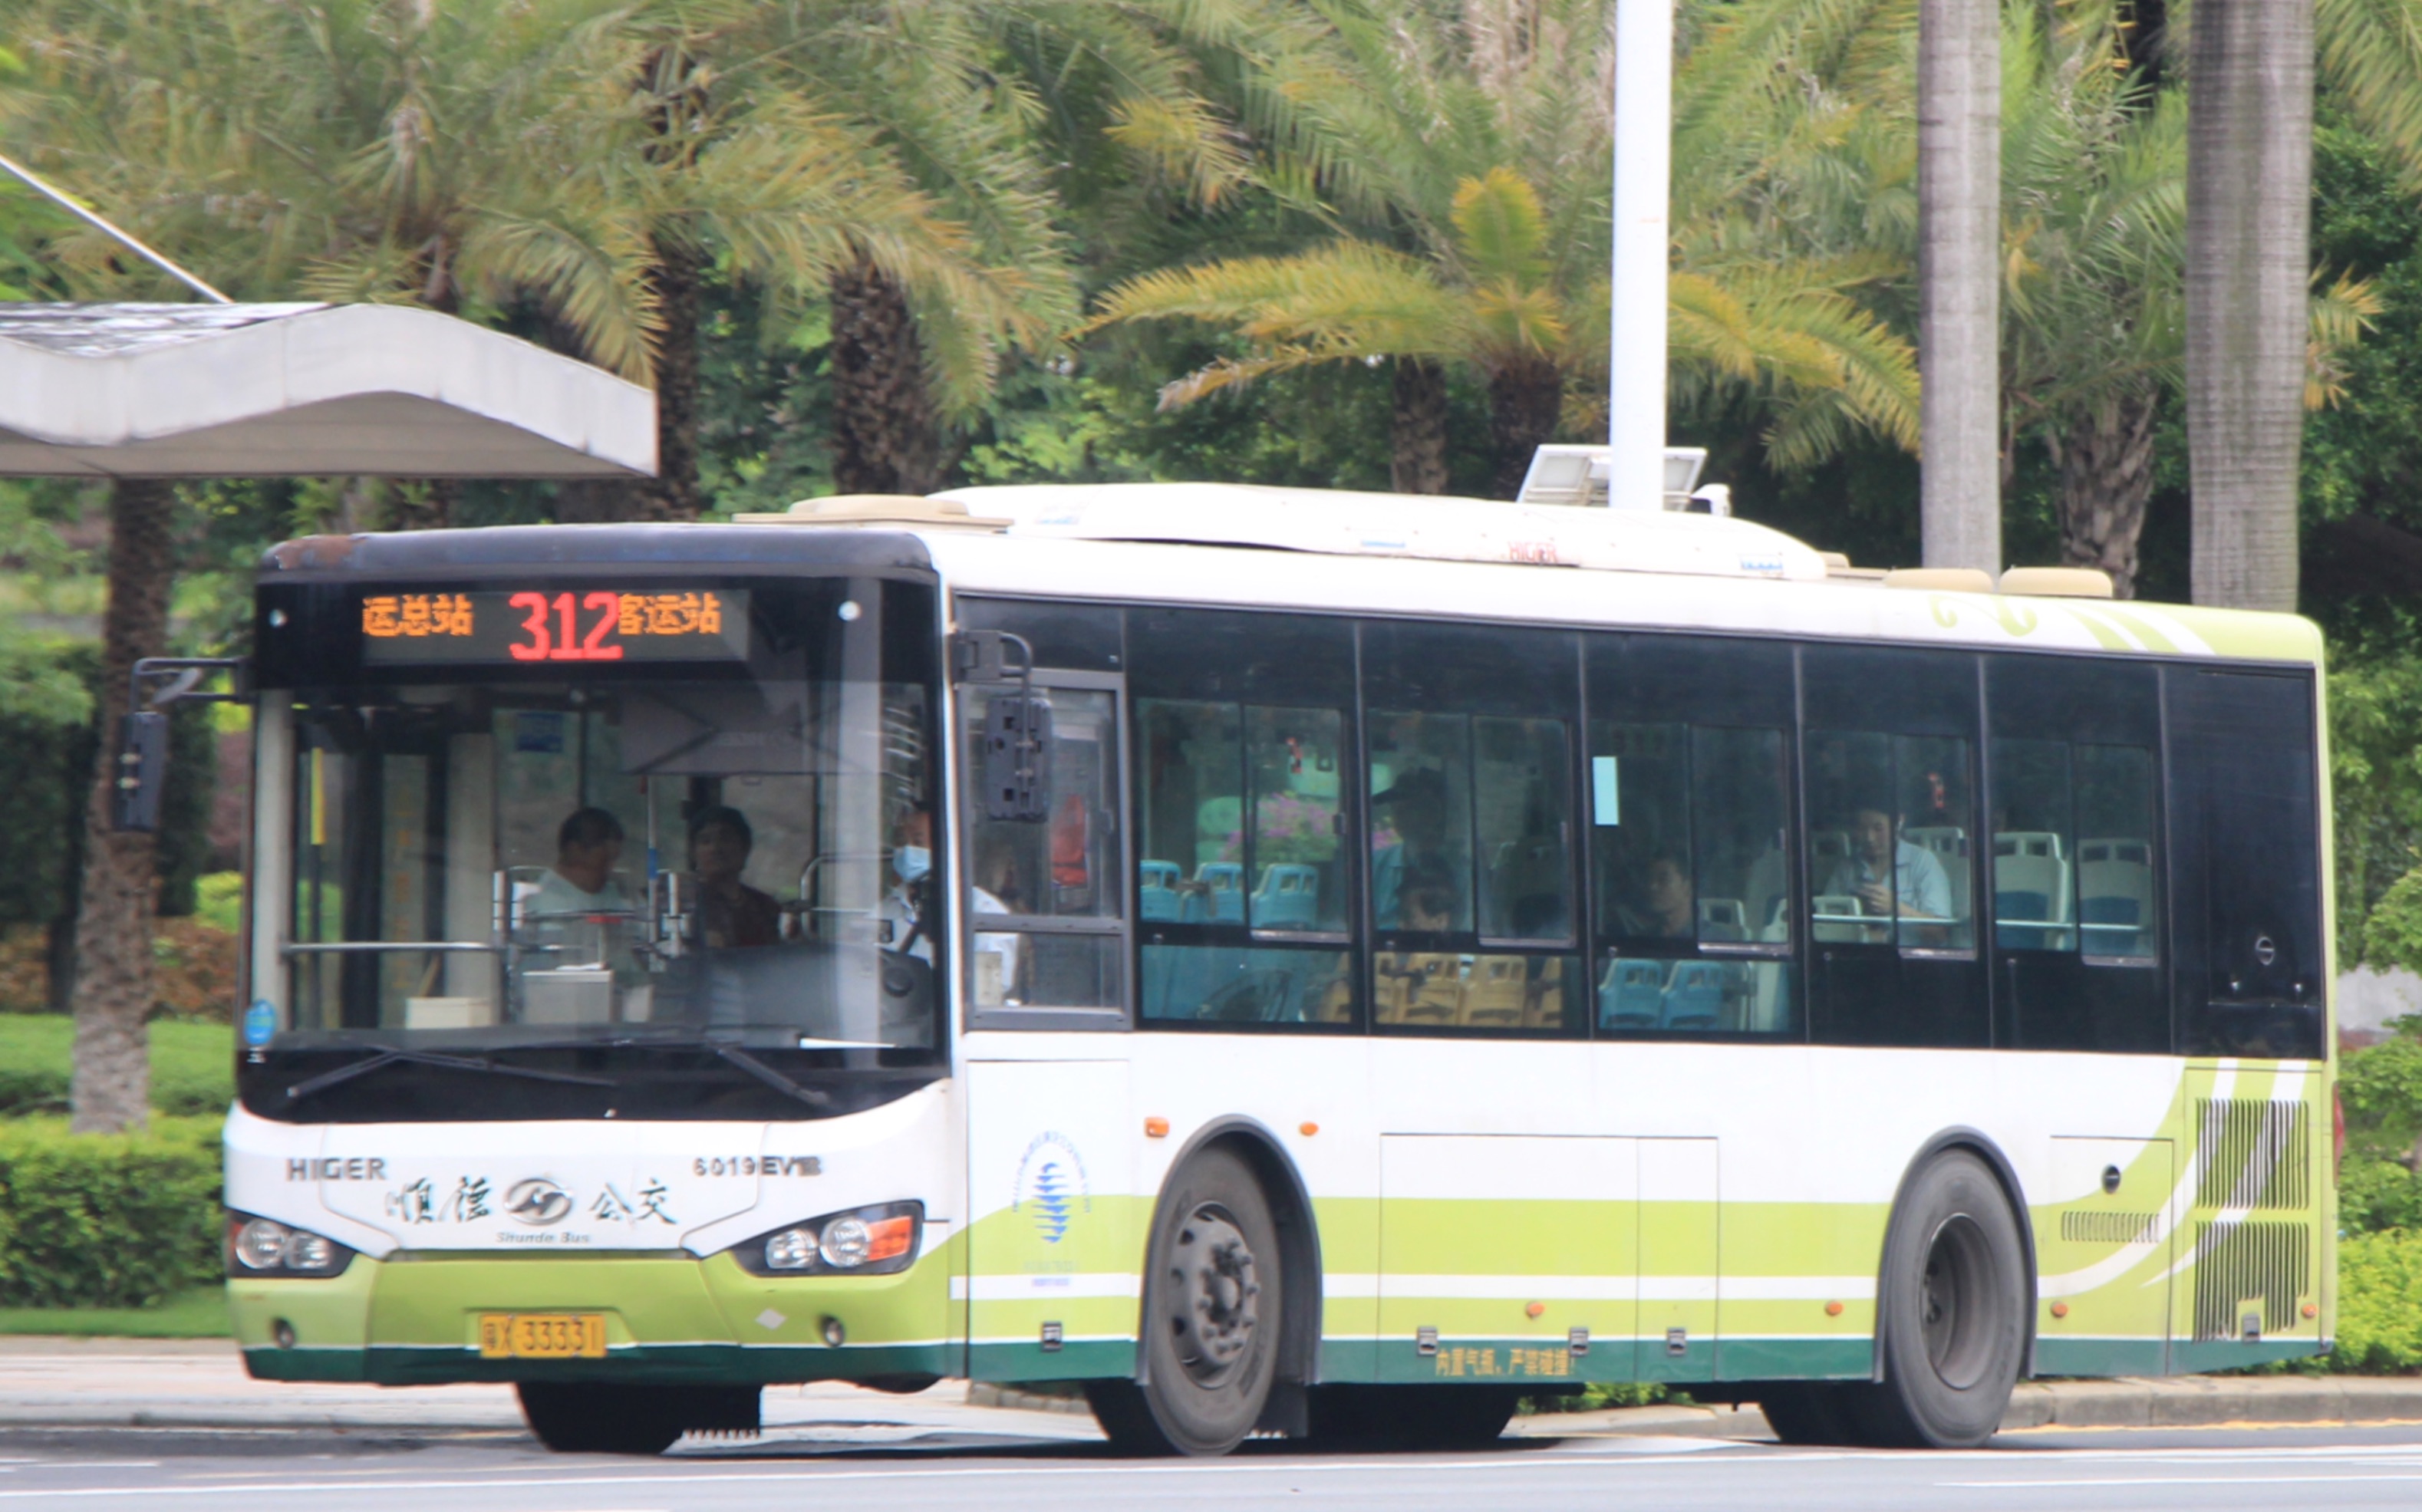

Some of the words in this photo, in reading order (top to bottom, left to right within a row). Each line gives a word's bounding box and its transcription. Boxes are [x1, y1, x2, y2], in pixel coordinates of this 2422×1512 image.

[508, 592, 624, 659] 312
[618, 592, 721, 634] 客运站
[288, 1158, 385, 1180] HIGER
[590, 1179, 678, 1224] 公交
[496, 1231, 553, 1244] Shunde
[560, 1231, 591, 1243] Bus
